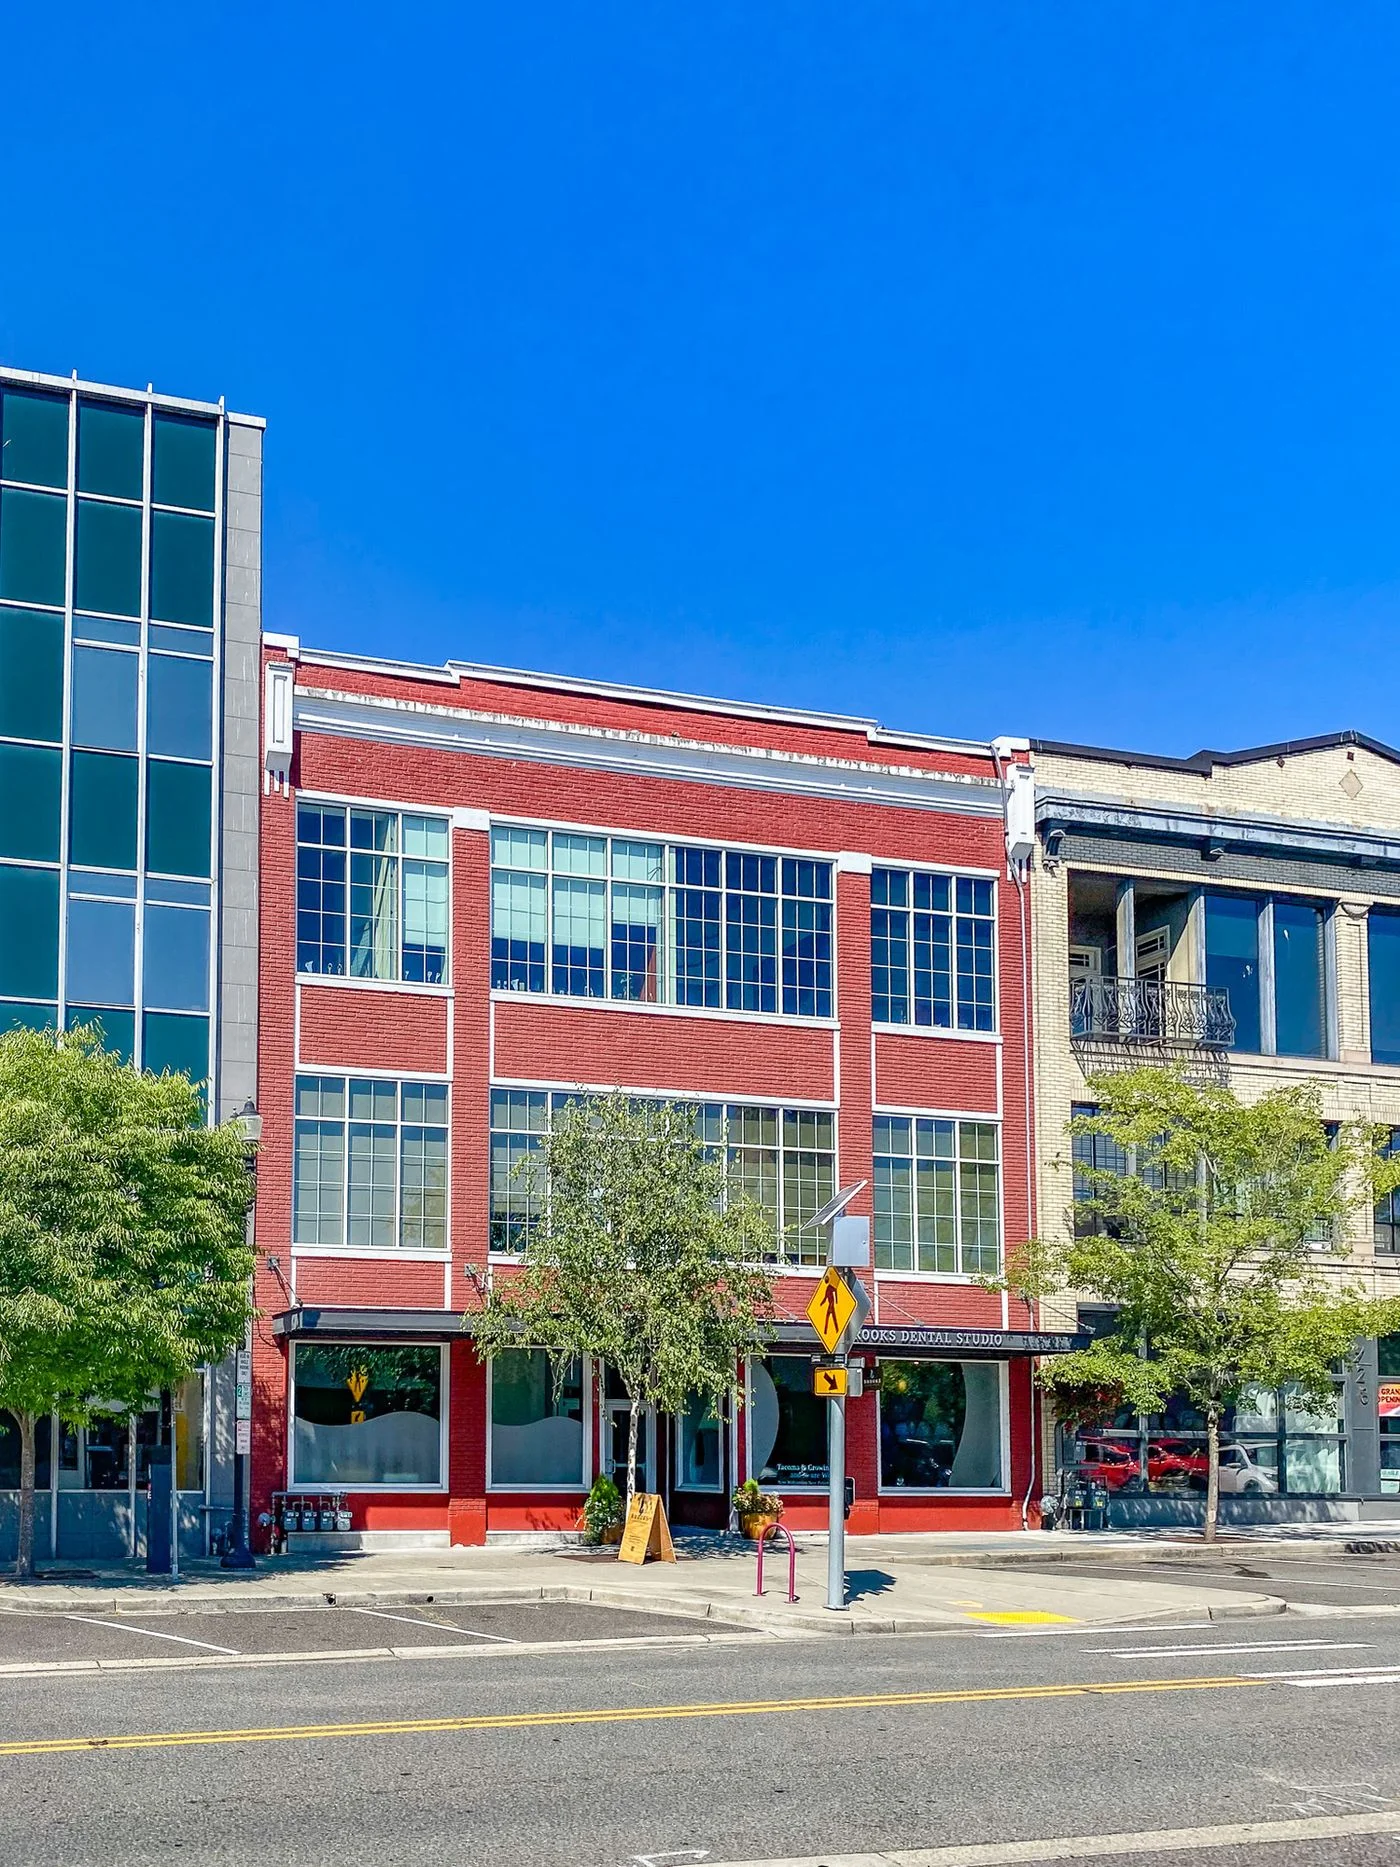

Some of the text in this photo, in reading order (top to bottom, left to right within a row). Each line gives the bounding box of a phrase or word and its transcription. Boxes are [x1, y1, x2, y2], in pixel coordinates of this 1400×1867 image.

[855, 1329, 1003, 1345] ROOKS DENTAL STUDIO
